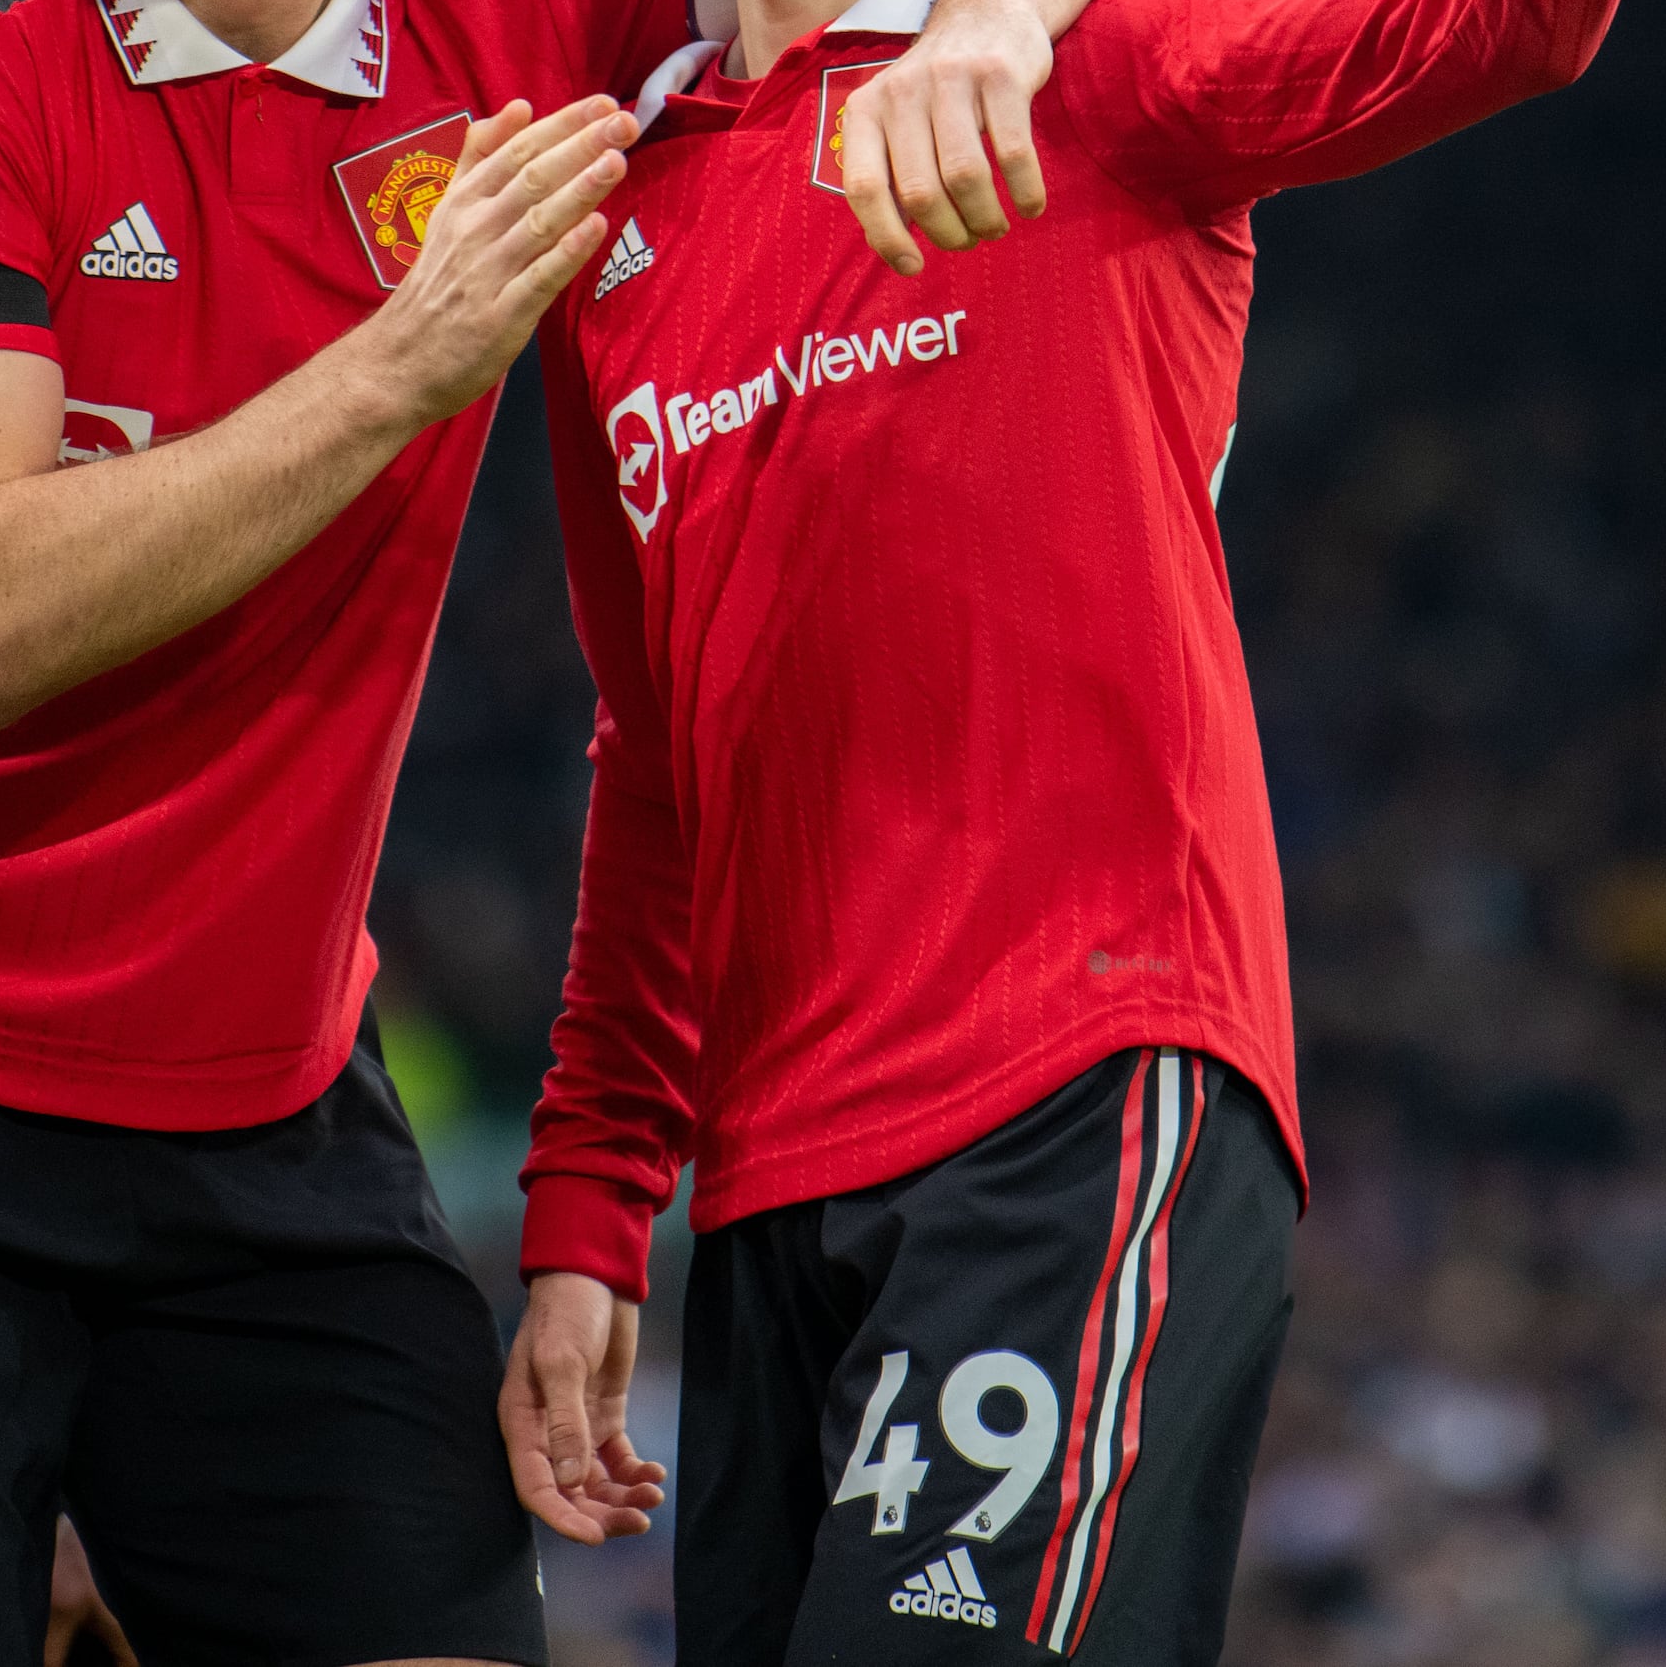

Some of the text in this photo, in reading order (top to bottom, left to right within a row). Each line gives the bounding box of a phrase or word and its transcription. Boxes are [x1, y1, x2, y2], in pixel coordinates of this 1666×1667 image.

[378, 159, 456, 216] MANCHESTE
[80, 250, 179, 281] adidas
[594, 247, 654, 301] adidas
[665, 310, 966, 454] TeamViewer
[833, 1348, 1061, 1543] 49
[889, 1589, 997, 1629] adidas
